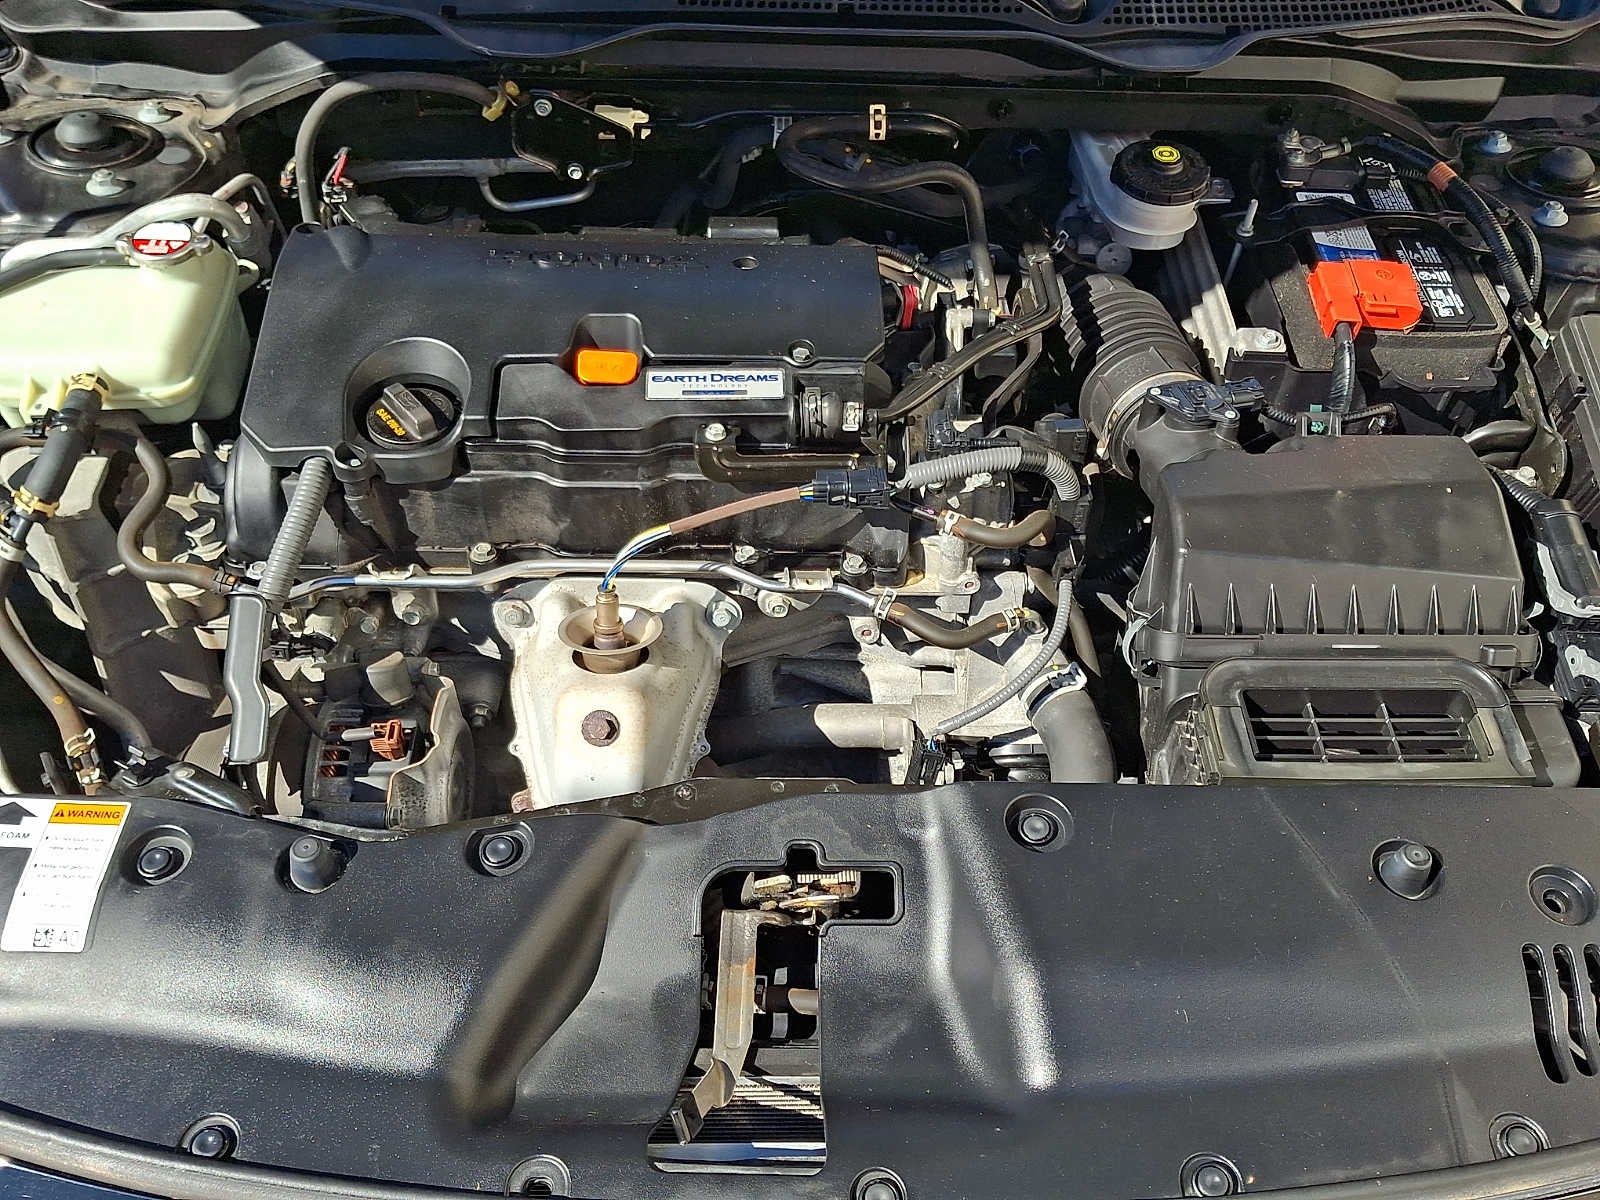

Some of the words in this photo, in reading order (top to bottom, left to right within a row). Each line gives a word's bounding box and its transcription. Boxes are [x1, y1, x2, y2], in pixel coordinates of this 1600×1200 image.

[651, 375, 707, 383] EARTH
[710, 374, 779, 383] DREAMS
[376, 408, 391, 422] SAE
[386, 419, 406, 436] 0W-20
[67, 809, 121, 820] WARNING
